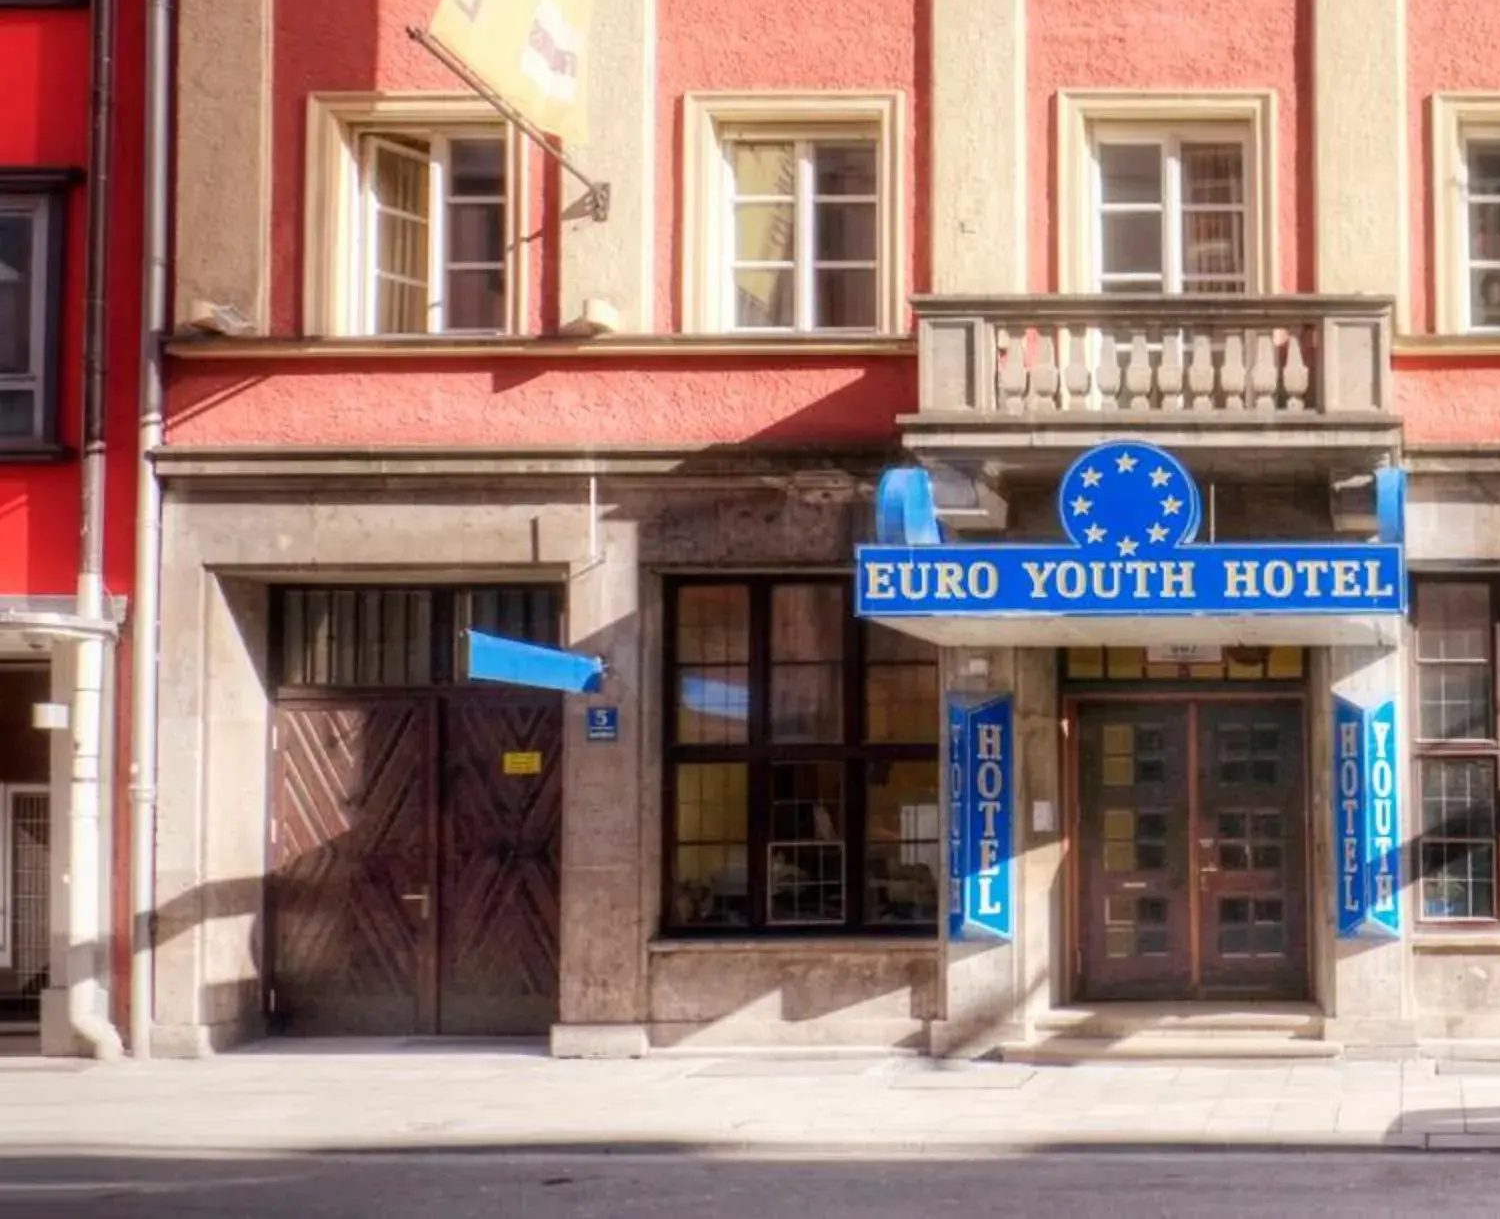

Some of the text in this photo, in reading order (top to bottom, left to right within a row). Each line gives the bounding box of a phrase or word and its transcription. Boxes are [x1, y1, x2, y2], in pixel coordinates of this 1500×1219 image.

[865, 559, 1393, 600] EURO YOUTH HOTEL
[976, 723, 1003, 915] HOTEL
[1341, 721, 1359, 911] HOTEL
[1371, 721, 1394, 912] YOUTH
